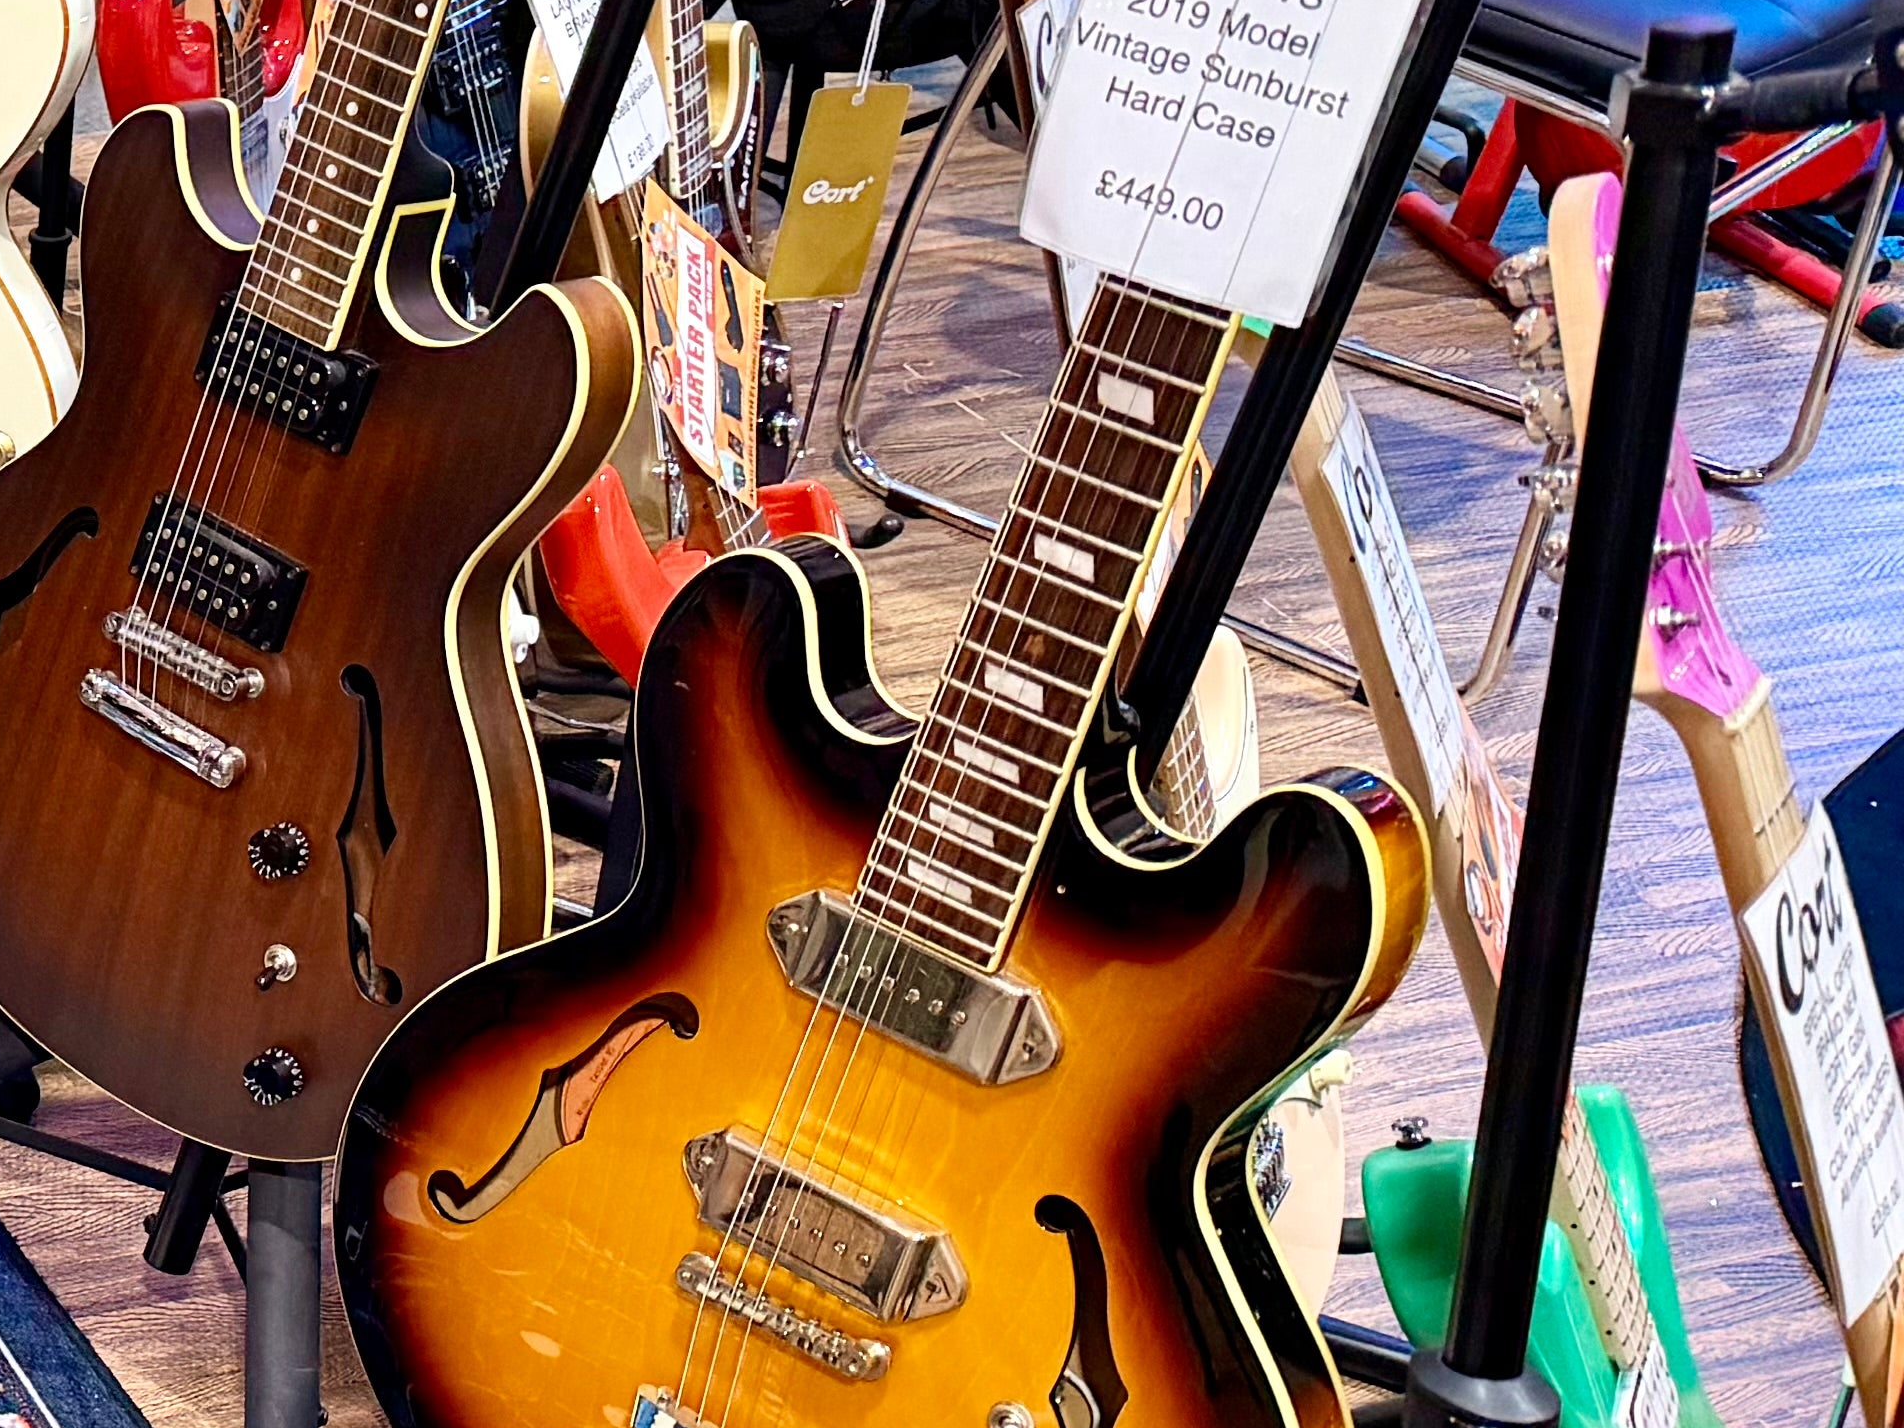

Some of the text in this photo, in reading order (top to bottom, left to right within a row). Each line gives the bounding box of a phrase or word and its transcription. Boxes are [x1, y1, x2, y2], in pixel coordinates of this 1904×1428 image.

[1076, 17, 1192, 77] Vintage
[1201, 53, 1351, 120] Sunburst
[1220, 8, 1320, 62] Model
[1105, 76, 1276, 150] Hard Case
[802, 179, 868, 206] Cort
[1094, 169, 1225, 232] £449.00
[684, 242, 706, 447] STARTER PACK
